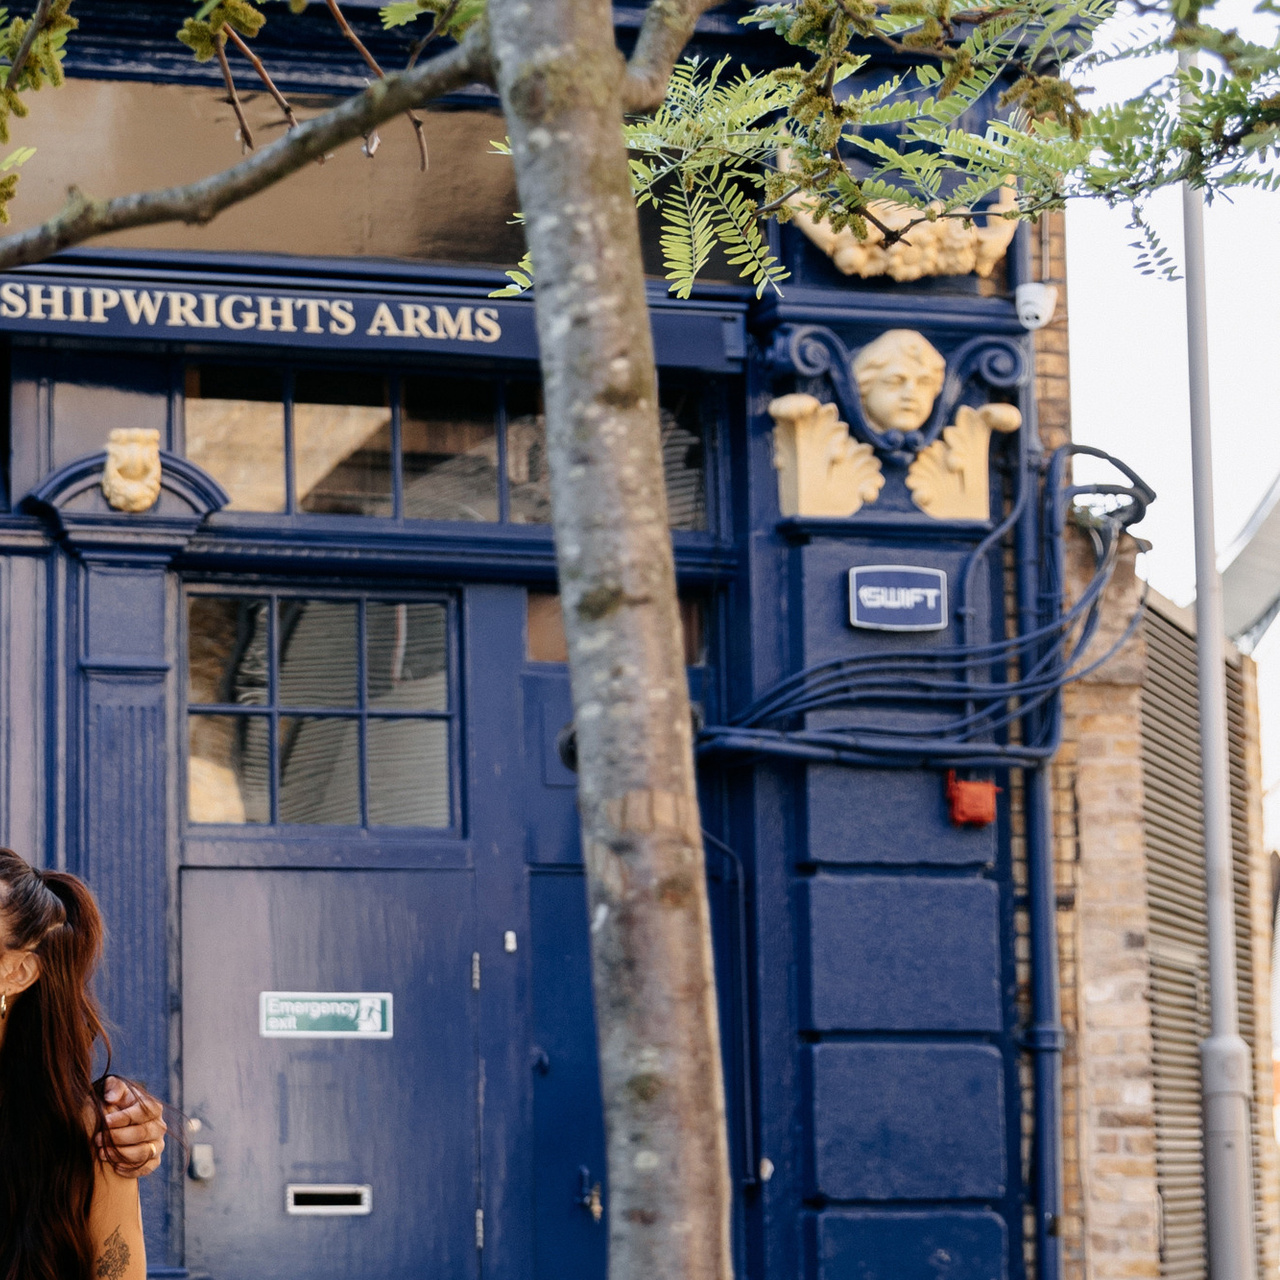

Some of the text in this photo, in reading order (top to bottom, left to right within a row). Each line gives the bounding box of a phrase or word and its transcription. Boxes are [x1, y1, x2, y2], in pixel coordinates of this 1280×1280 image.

[0, 282, 356, 336] SHIPWRIGHTS
[366, 302, 502, 343] ARMS
[858, 585, 940, 610] SWIFT
[268, 999, 358, 1019] Emergency
[267, 1016, 297, 1030] exit
